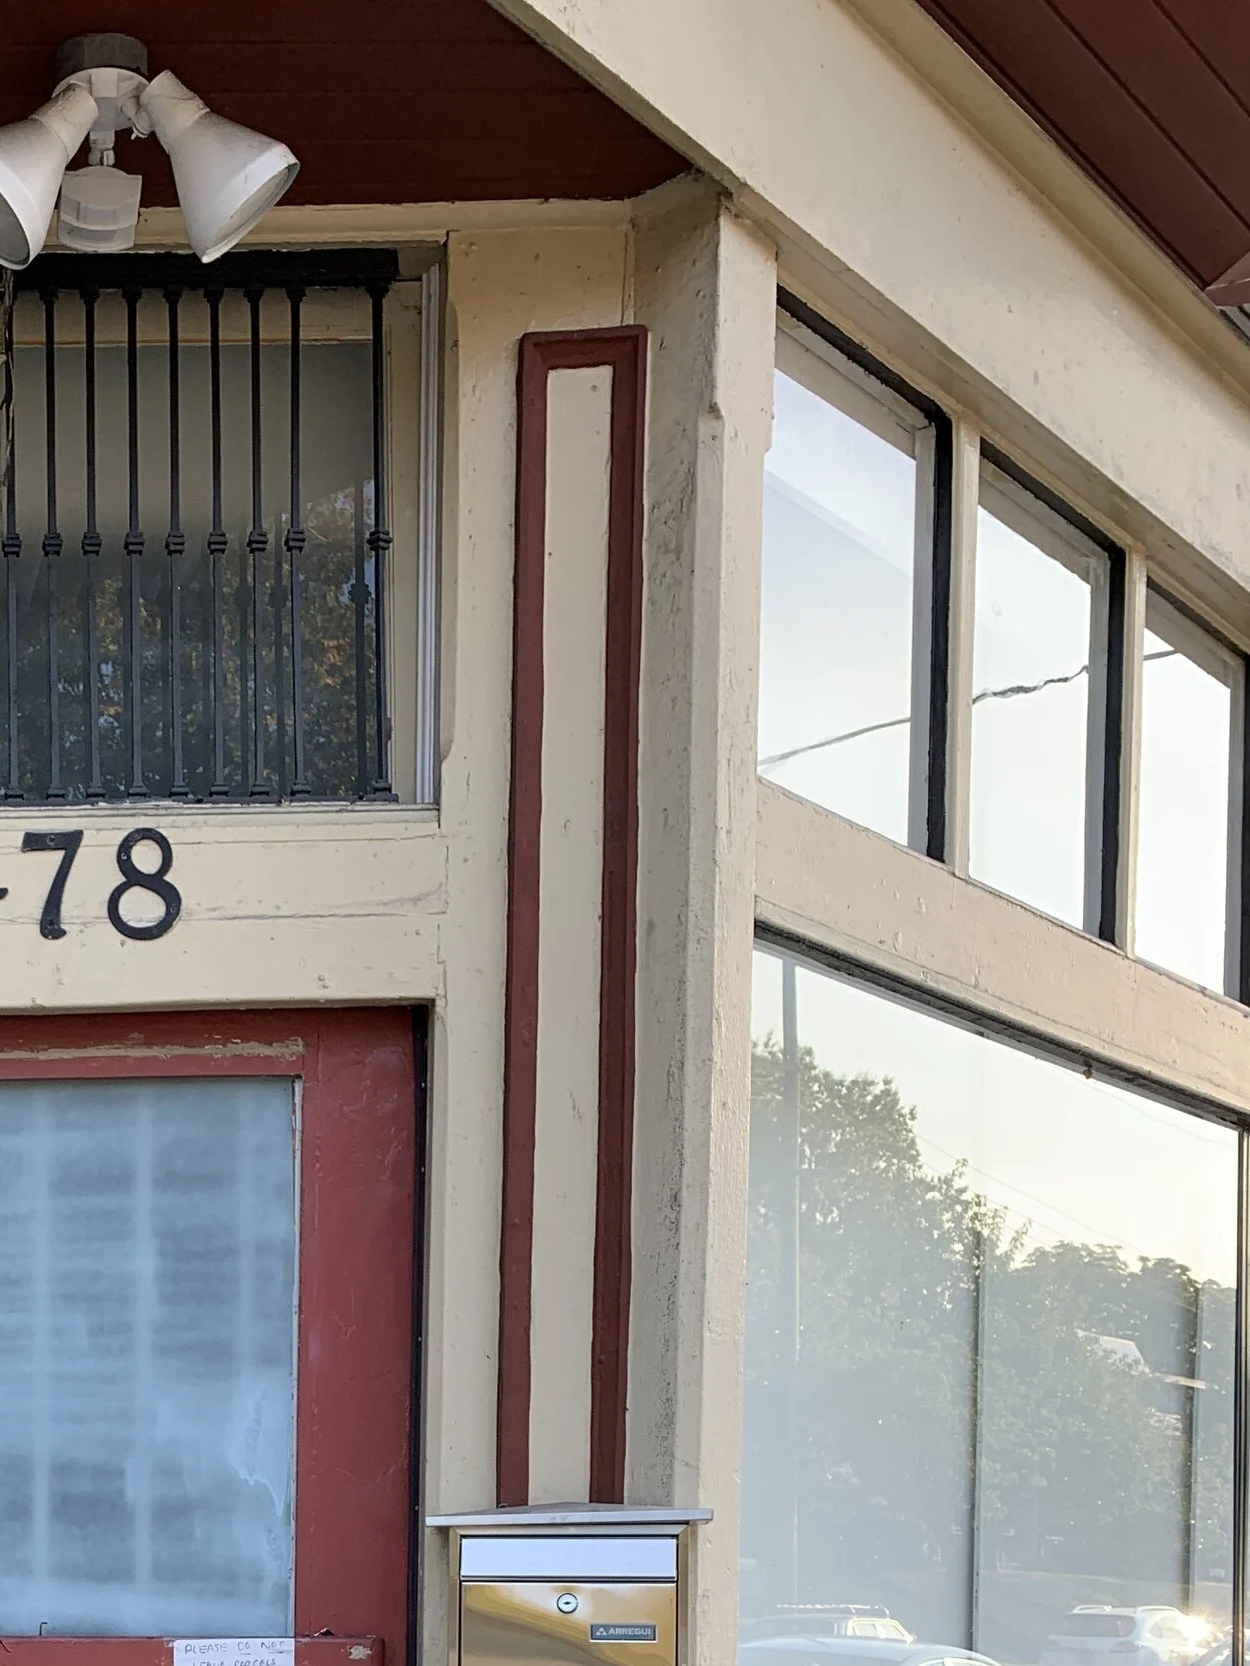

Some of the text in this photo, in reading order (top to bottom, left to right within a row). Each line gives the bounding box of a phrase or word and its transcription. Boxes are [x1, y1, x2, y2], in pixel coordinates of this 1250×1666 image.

[608, 1627, 651, 1635] ARREGUI
[184, 1641, 285, 1654] PLEASE DO NOT
